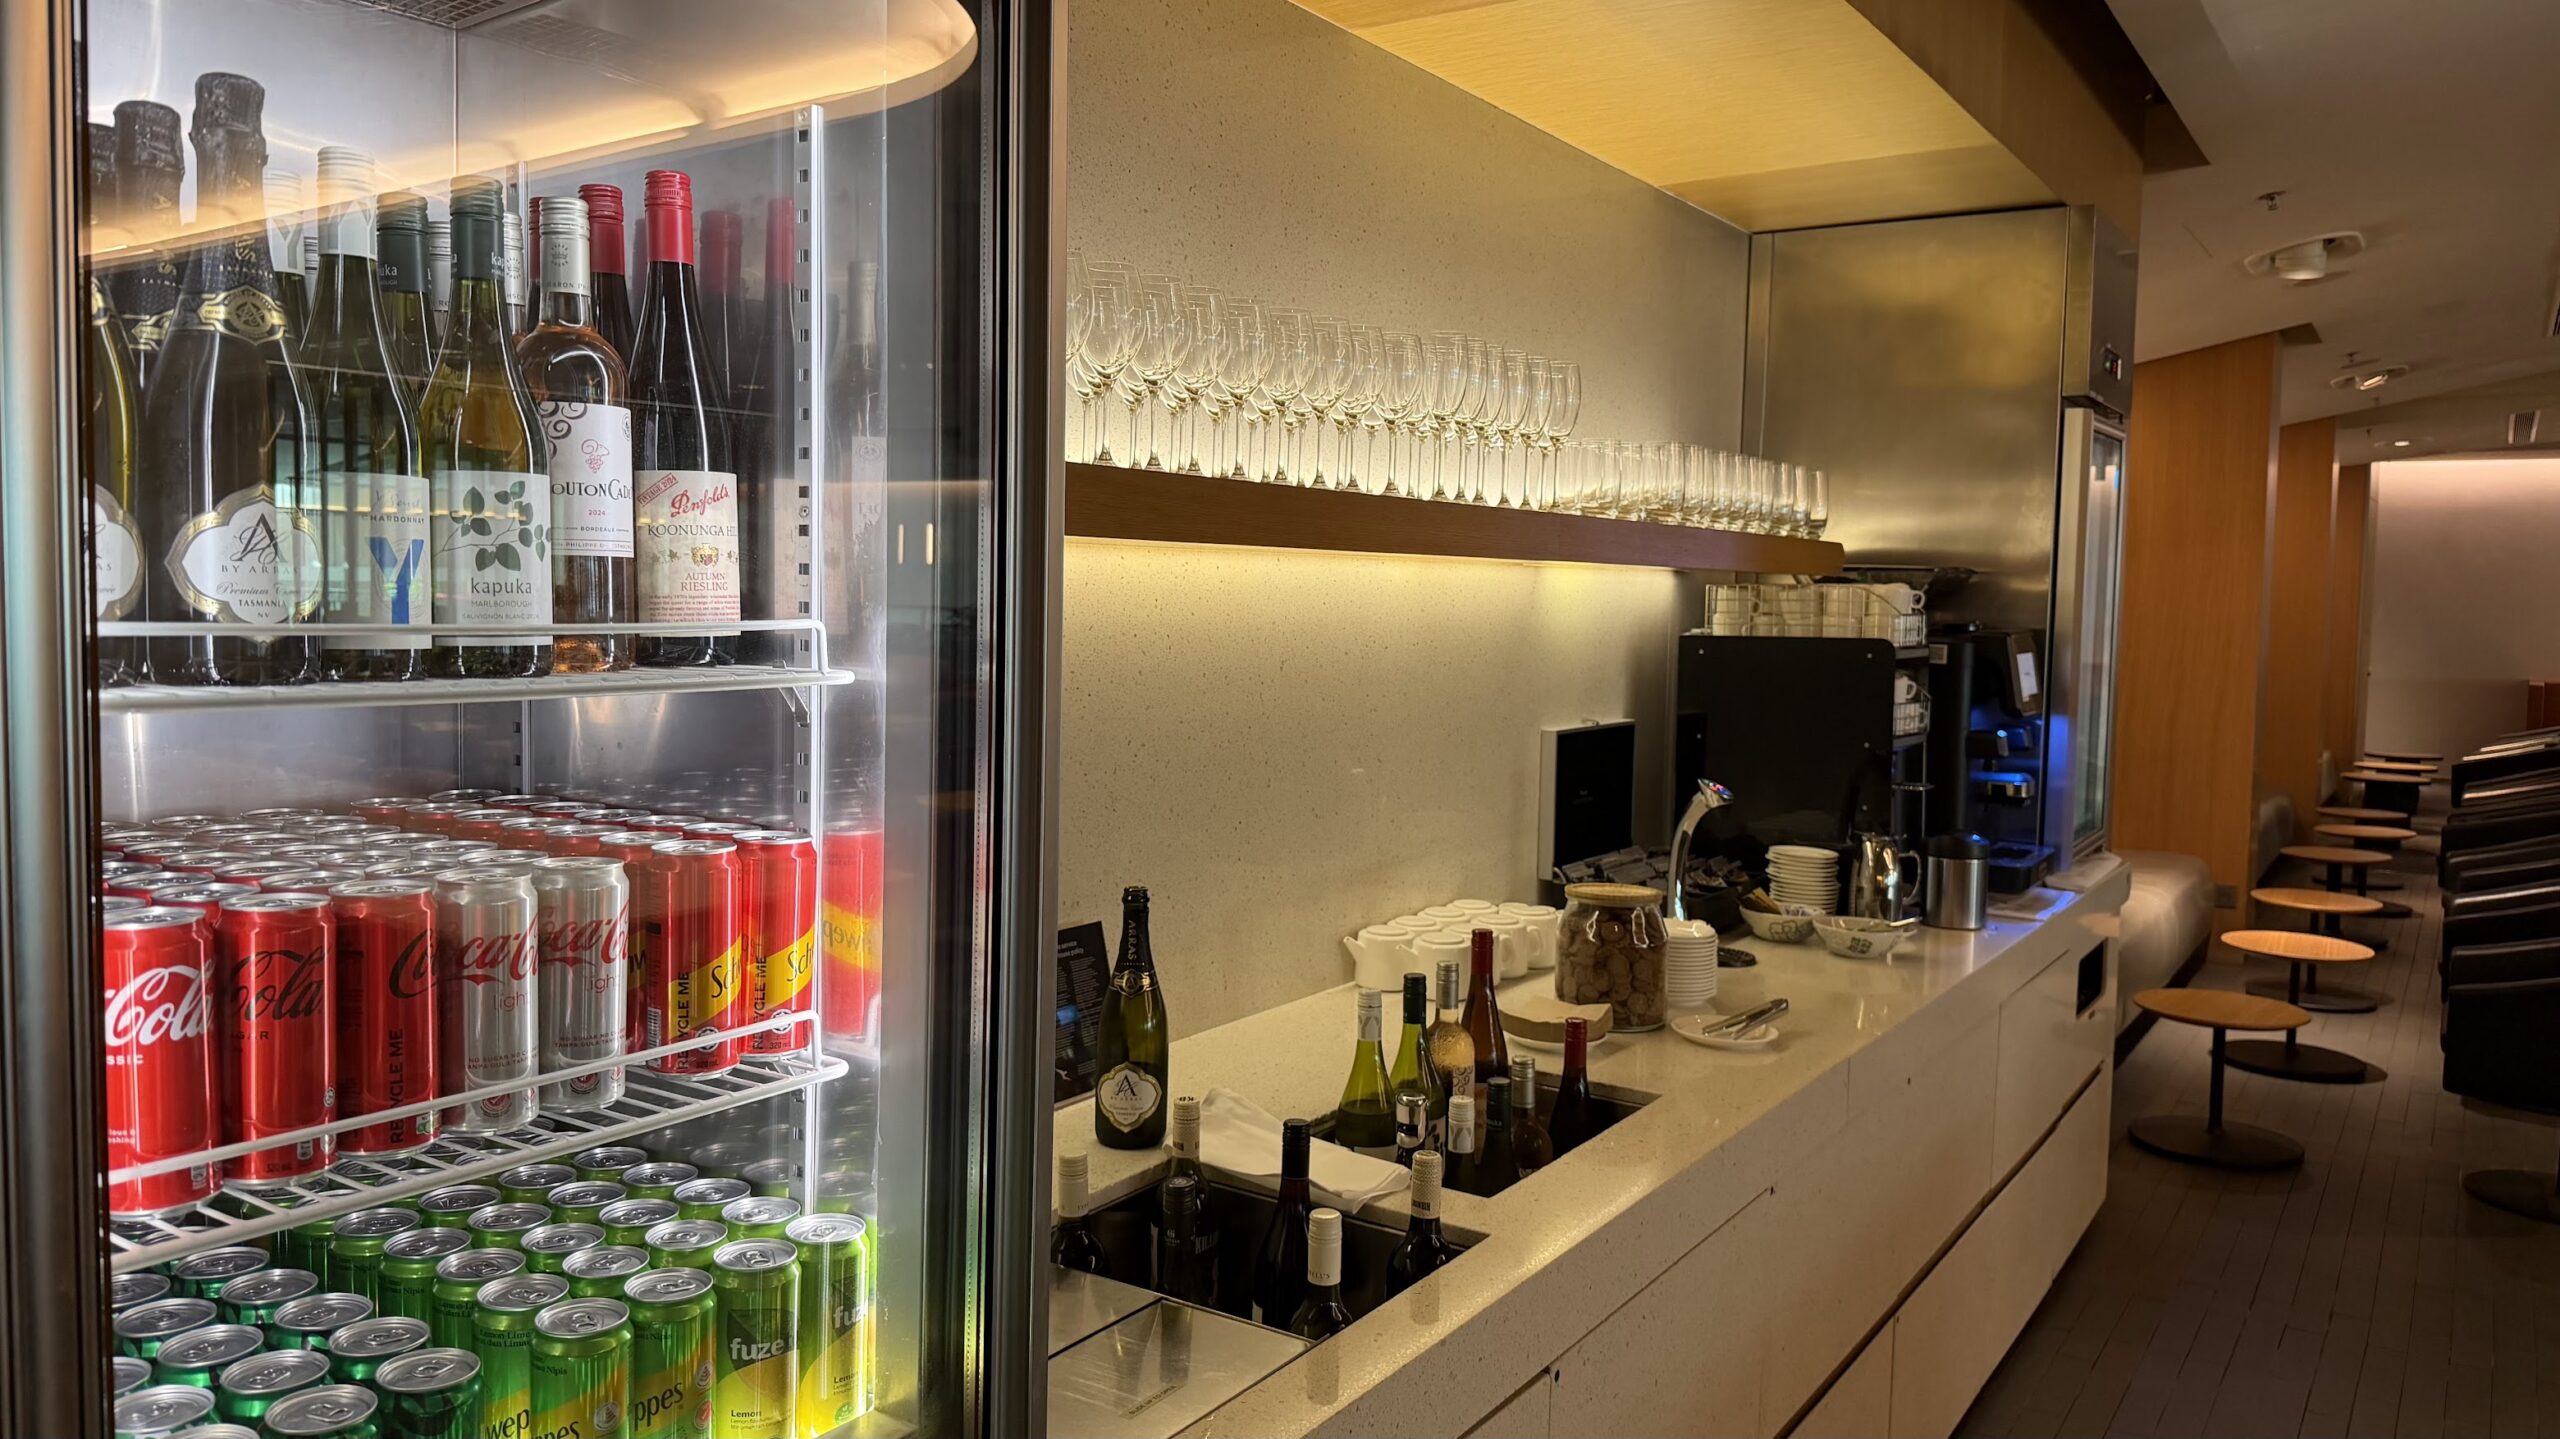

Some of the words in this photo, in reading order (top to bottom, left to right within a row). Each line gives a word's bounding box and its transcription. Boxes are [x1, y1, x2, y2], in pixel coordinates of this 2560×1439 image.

[671, 483, 729, 518] Penfolds
[648, 524, 725, 538] KOONUNGA
[685, 572, 726, 581] AUTUMN
[216, 582, 269, 596] Premium
[471, 577, 532, 597] kapuka
[681, 581, 729, 592] RIESLING
[239, 599, 288, 608] TASMANIA
[471, 600, 533, 608] MARLBOROUGH
[1127, 919, 1137, 961] ARRAS
[755, 954, 767, 979] ME
[678, 971, 690, 996] ME
[389, 1028, 404, 1055] ME
[482, 1054, 509, 1063] SUGAR
[730, 1336, 785, 1360] fuze
[546, 1367, 568, 1376] Nipis
[731, 1409, 762, 1418] Lemon
